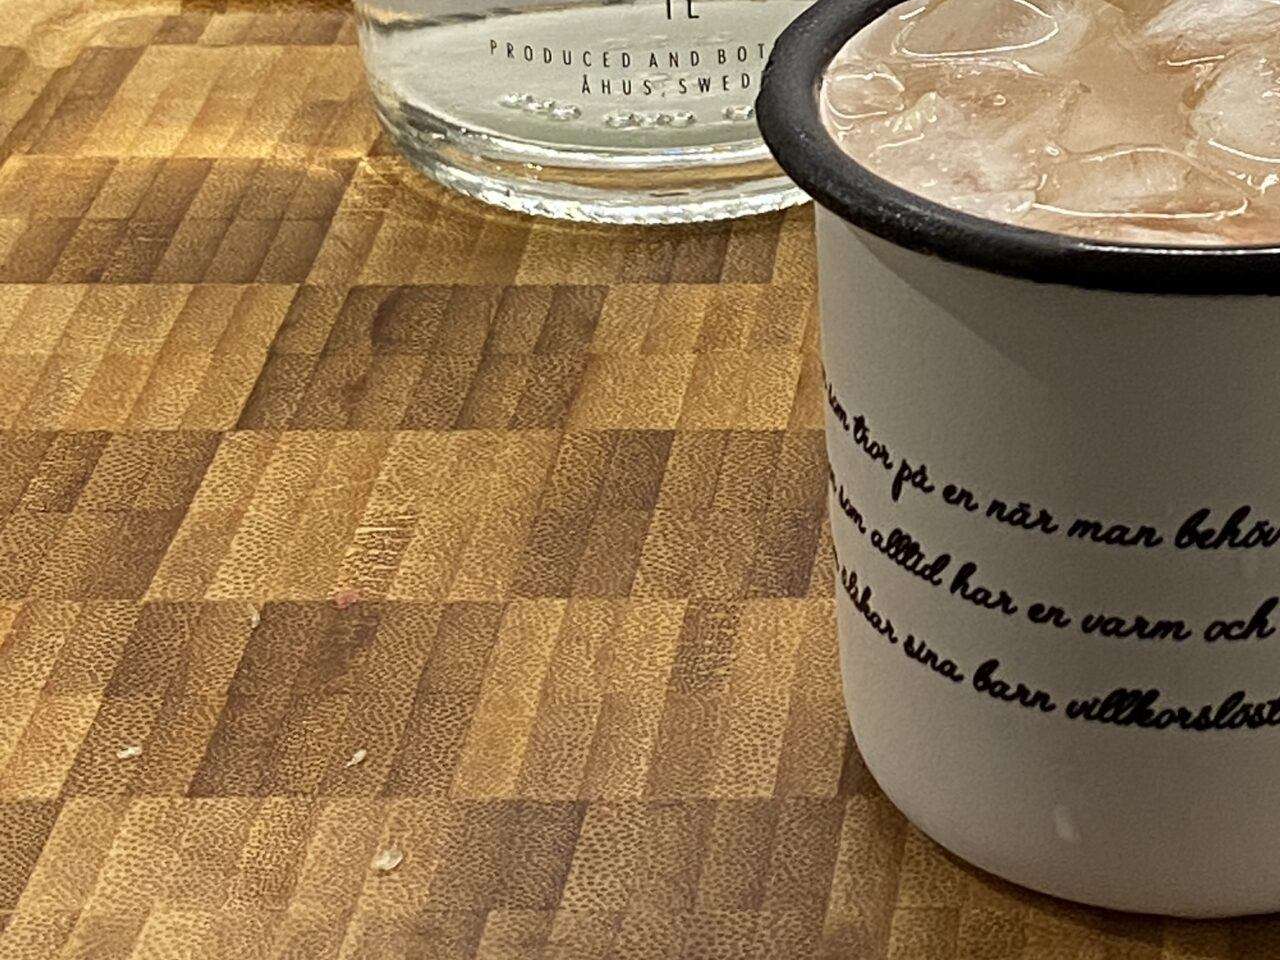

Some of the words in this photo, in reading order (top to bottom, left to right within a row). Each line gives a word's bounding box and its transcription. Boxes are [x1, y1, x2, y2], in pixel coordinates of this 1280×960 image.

[489, 39, 632, 70] PRODUCED
[648, 50, 701, 70] AND
[852, 414, 894, 471] tror
[891, 458, 936, 504] på
[941, 483, 979, 512] en
[985, 499, 1059, 535] när
[1066, 518, 1164, 548] man
[870, 527, 952, 587] alltid
[949, 561, 1019, 616] har
[1027, 603, 1072, 629] en
[1081, 614, 1192, 642] varm
[1203, 596, 1280, 643] och
[902, 633, 965, 684] sina
[972, 658, 1057, 713] barn
